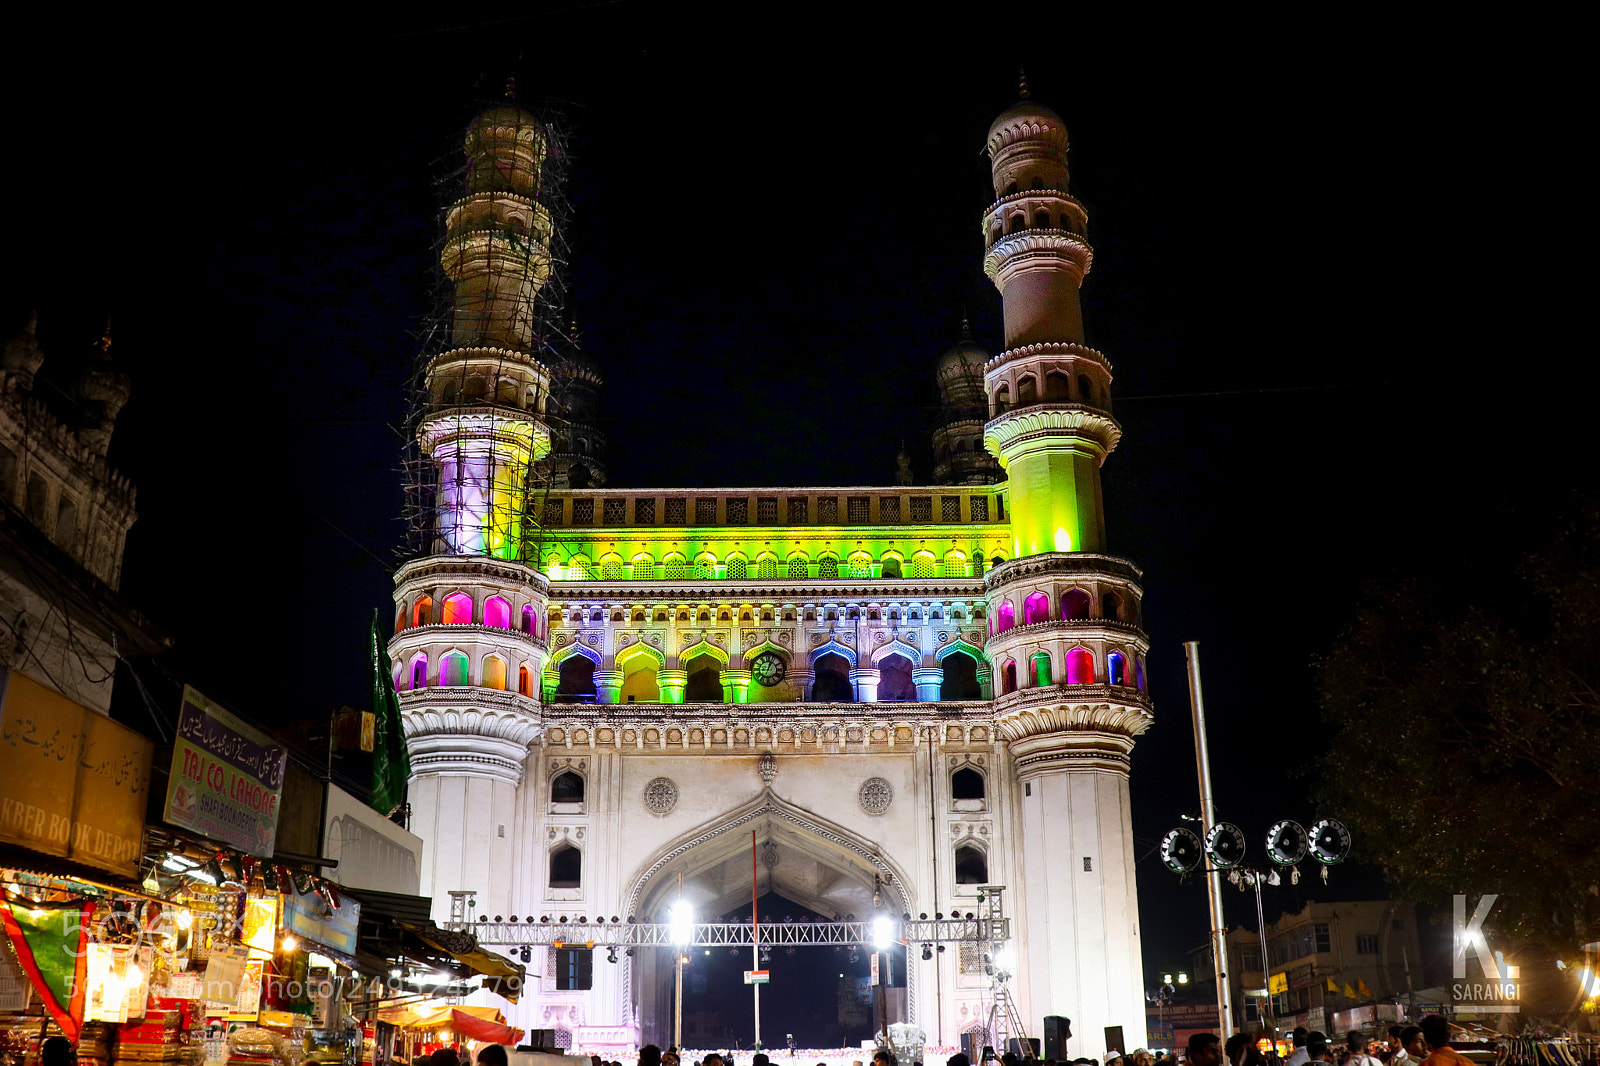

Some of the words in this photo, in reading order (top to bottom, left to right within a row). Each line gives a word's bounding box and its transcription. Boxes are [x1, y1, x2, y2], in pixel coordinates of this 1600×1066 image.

[181, 747, 204, 784] TAJ
[206, 761, 226, 796] CO.
[230, 773, 276, 818] LAHORE
[258, 748, 278, 780] کمپنی
[219, 802, 236, 824] BOOK
[237, 809, 257, 832] DEPOT
[48, 813, 92, 852] BOOK
[94, 829, 139, 862] DEPOT
